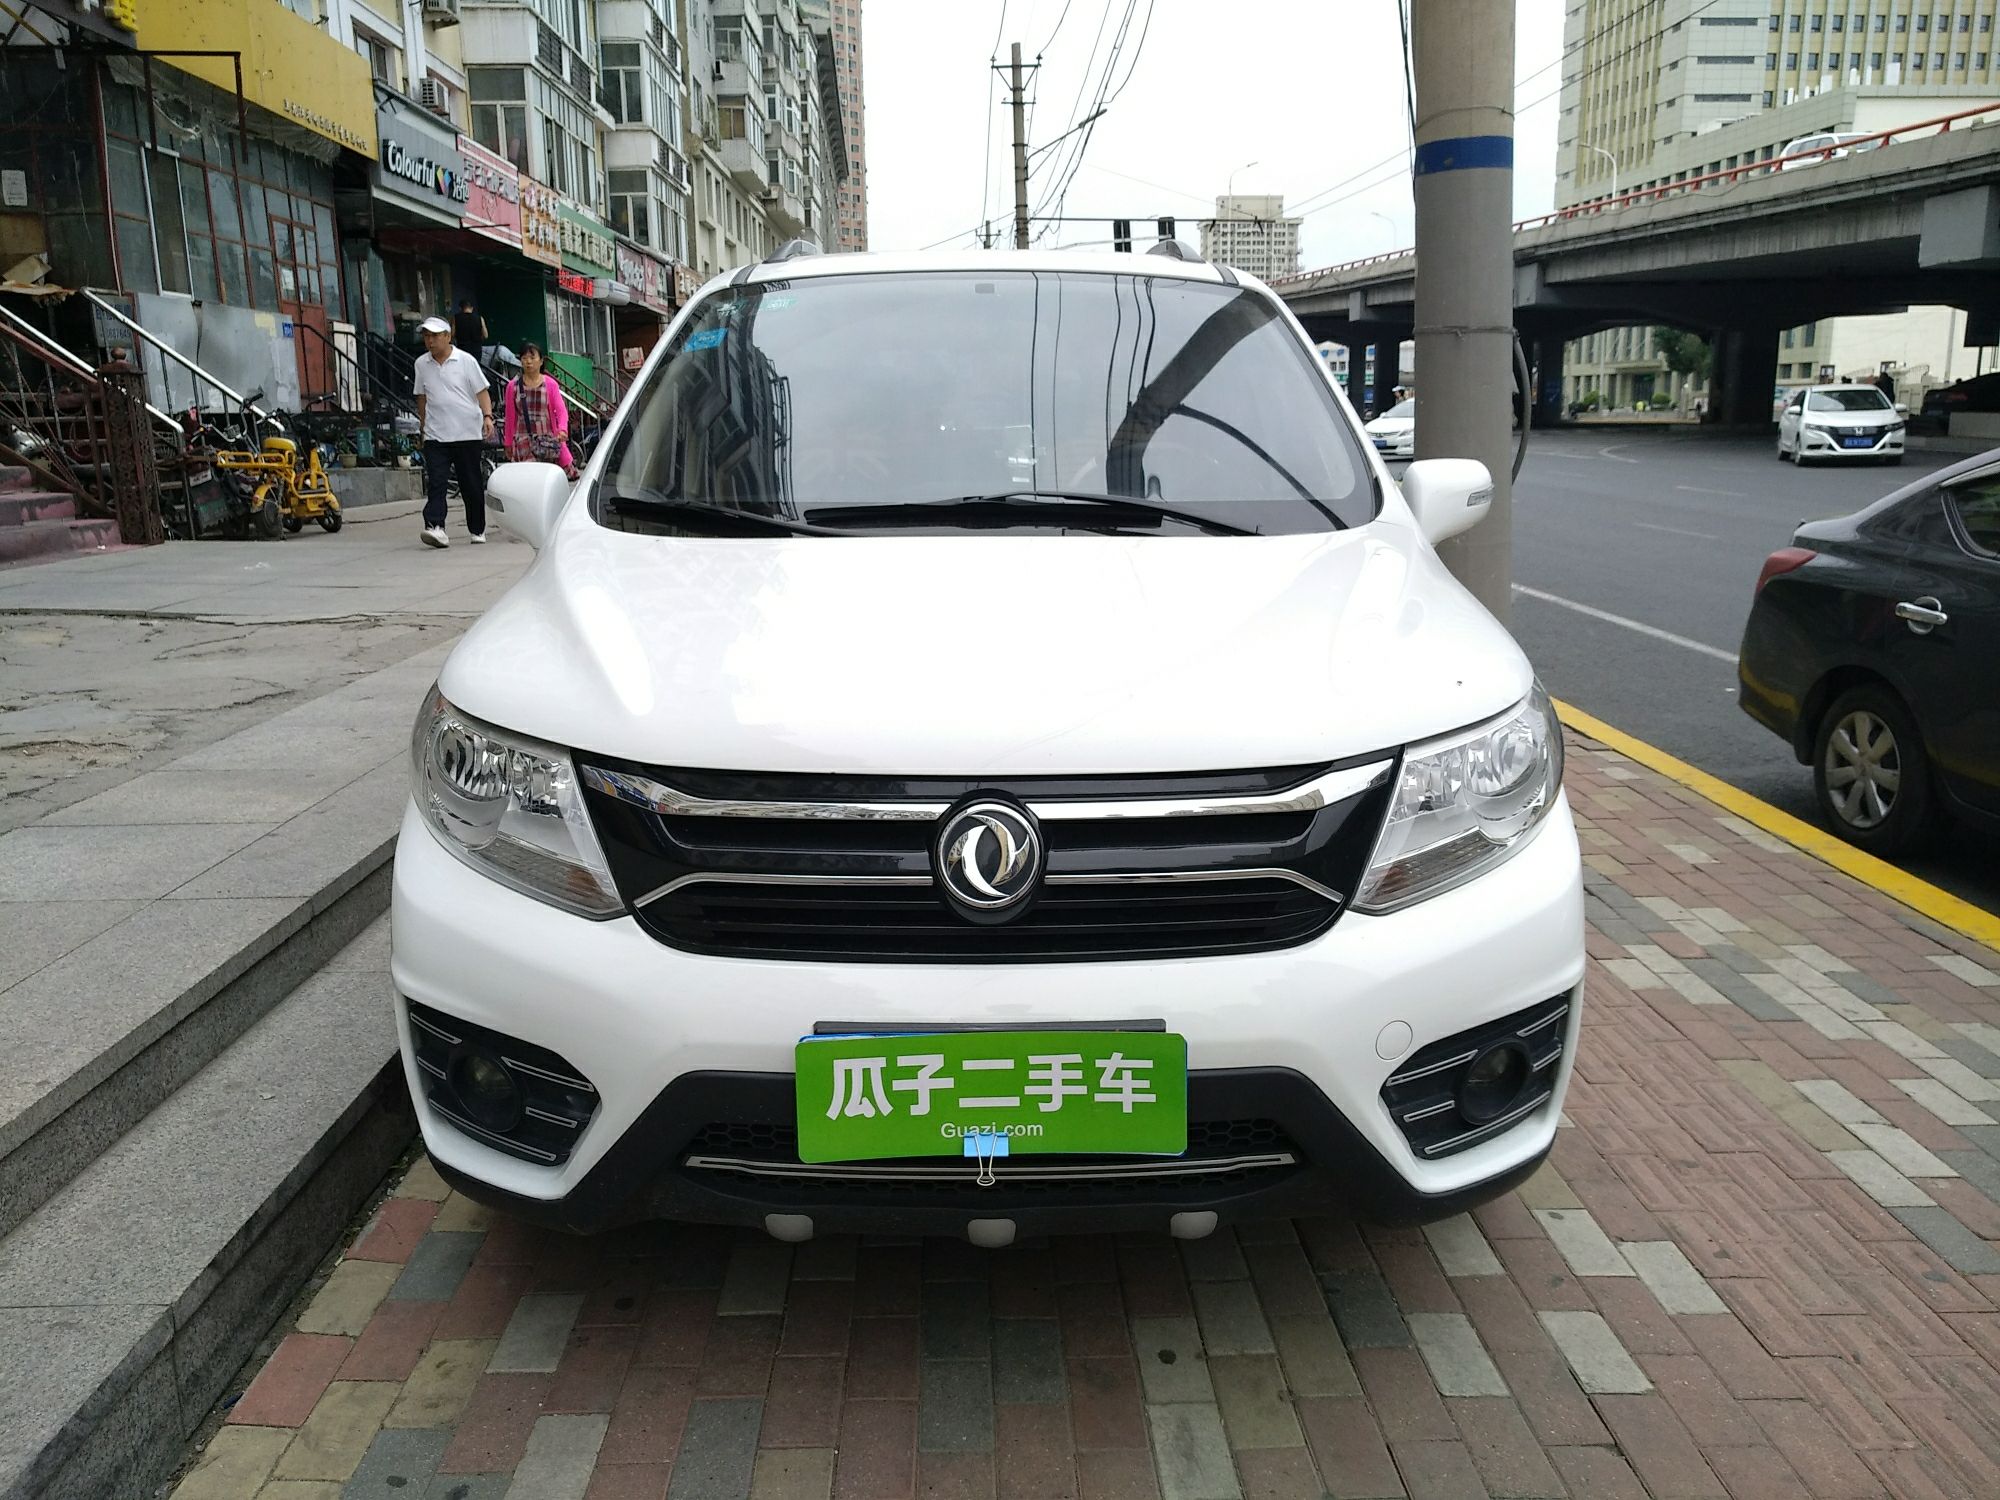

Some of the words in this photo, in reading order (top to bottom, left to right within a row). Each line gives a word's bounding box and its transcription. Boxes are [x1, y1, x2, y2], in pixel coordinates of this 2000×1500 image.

[387, 139, 436, 189] Colourful
[826, 1051, 1157, 1121] 瓜子二手车
[940, 1121, 1044, 1139] Guazicom
